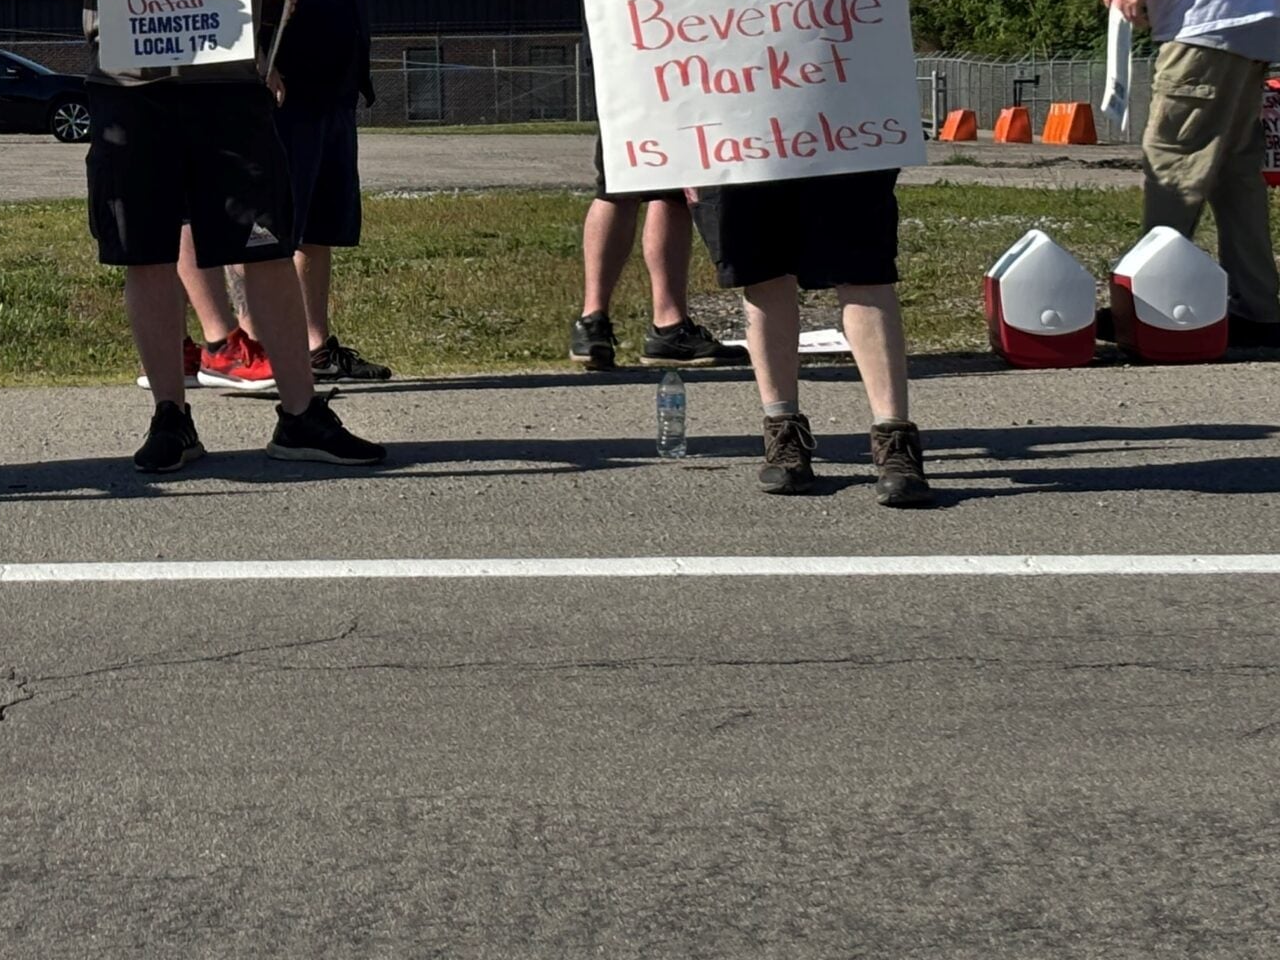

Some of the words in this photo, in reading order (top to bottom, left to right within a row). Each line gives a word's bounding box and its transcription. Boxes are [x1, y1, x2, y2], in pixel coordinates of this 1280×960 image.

[129, 12, 220, 35] TEAMSTERS
[134, 38, 184, 56] LOCAL
[189, 34, 218, 52] 175
[677, 112, 908, 170] Tasteless
